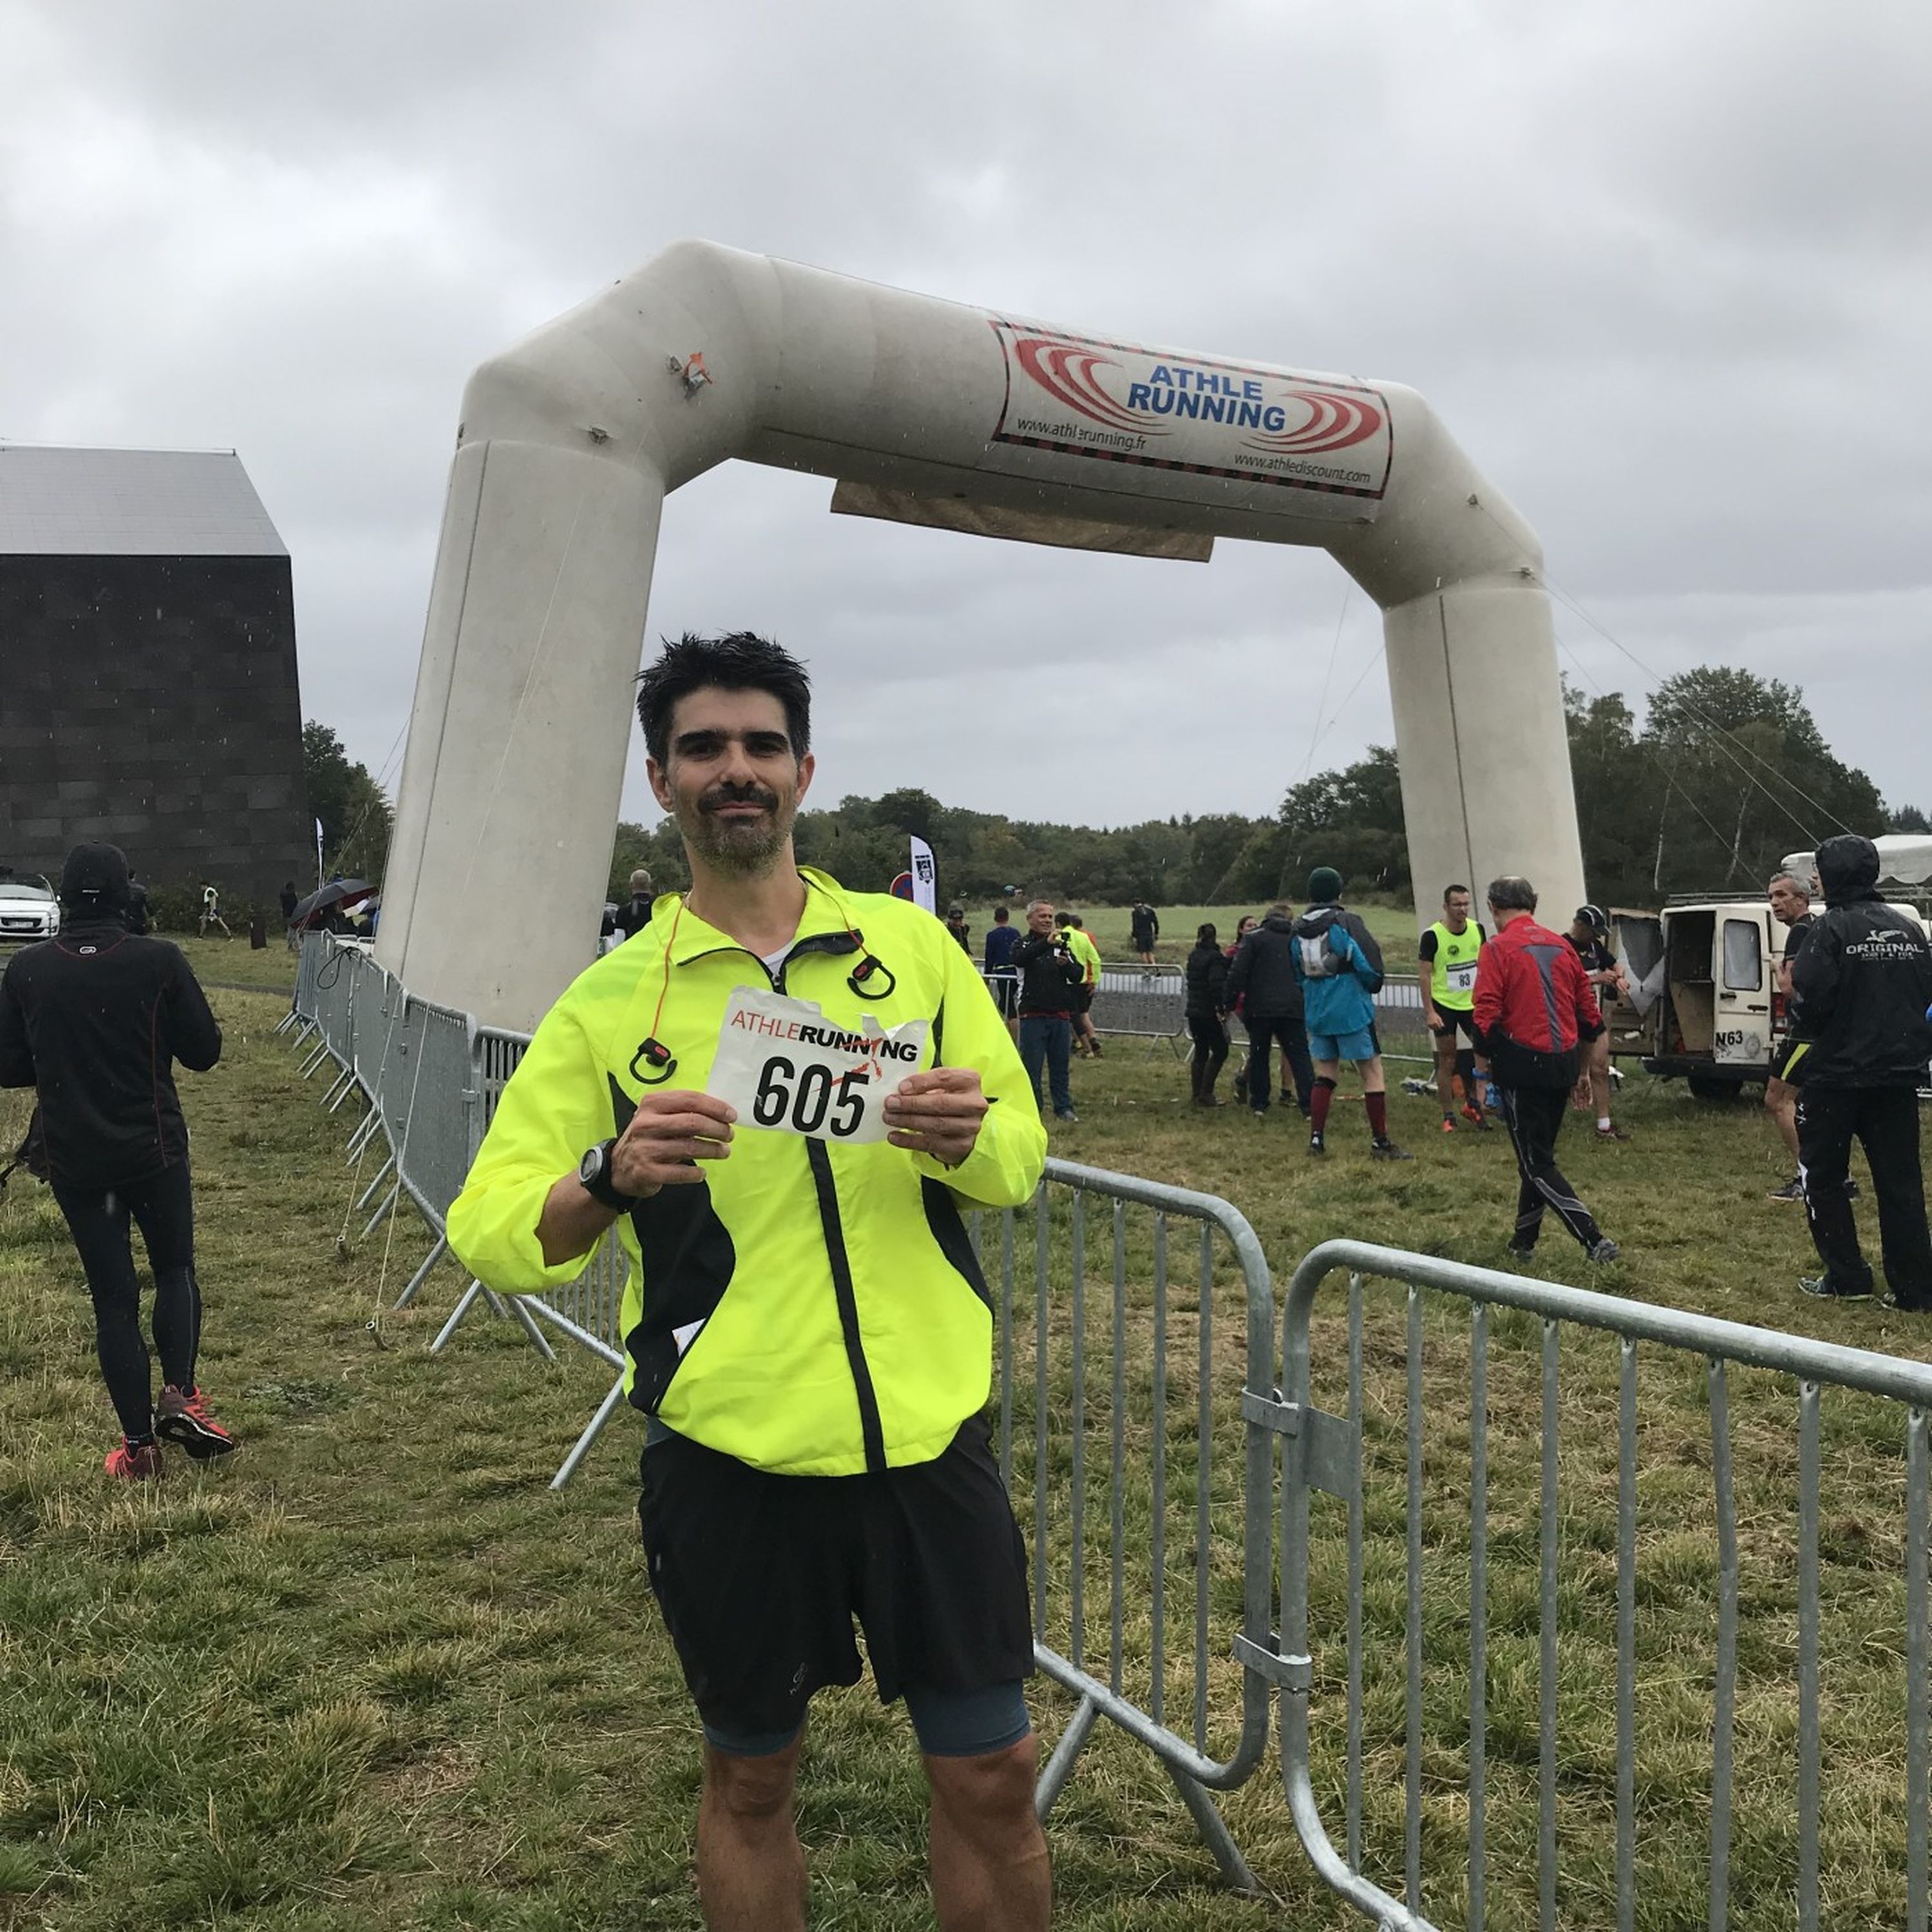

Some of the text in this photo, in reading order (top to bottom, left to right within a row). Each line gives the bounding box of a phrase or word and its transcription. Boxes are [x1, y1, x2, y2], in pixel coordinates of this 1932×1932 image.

[1150, 365, 1263, 401] ATHLE
[1128, 383, 1285, 431] RUNNING
[1235, 454, 1371, 484] www.athlediscount.com
[753, 1056, 869, 1137] 605
